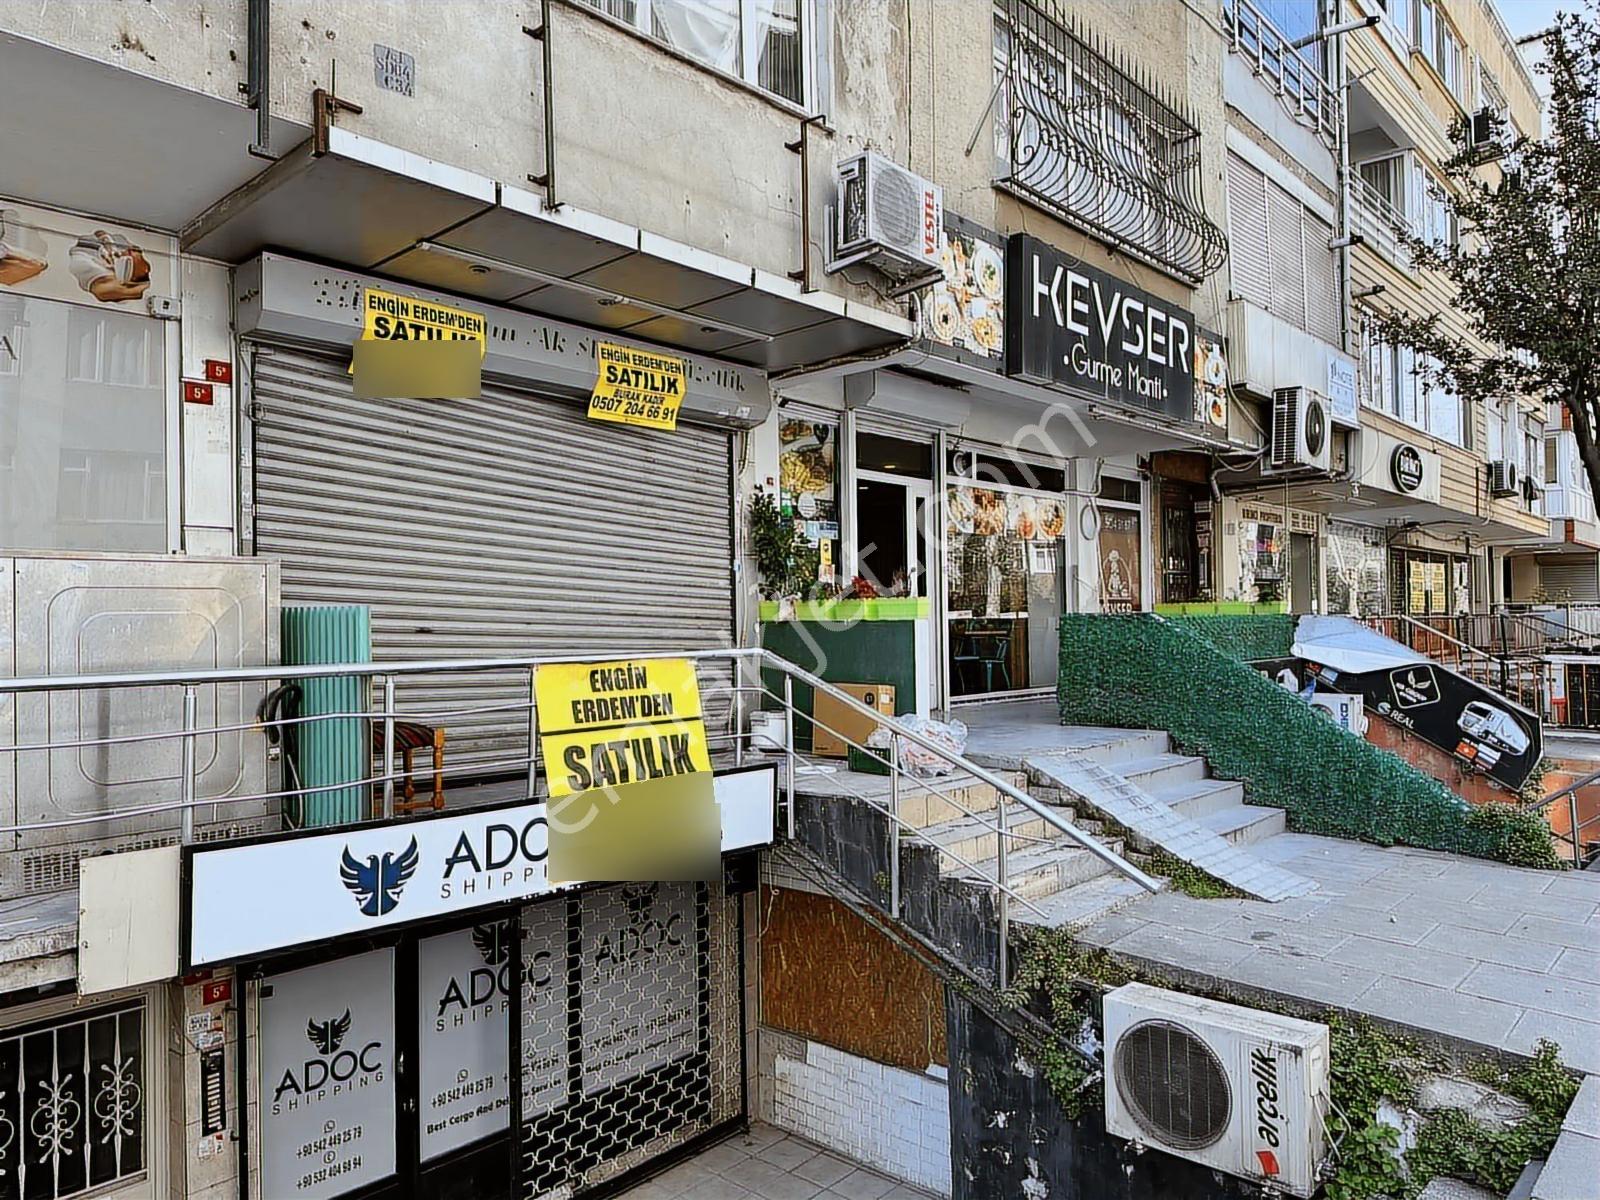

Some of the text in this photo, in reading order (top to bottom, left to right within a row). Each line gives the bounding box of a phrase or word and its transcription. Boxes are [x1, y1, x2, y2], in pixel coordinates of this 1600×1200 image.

[924, 189, 936, 255] VESTEL
[413, 305, 481, 333] ERDEM'DEN
[1032, 254, 1189, 374] KEVSER
[606, 364, 680, 395] SATILIK
[1071, 341, 1123, 388] Gurme
[591, 394, 676, 422] 0507 204 66 91
[589, 662, 648, 693] ENGİN
[571, 692, 674, 724] ERDEM'DEN
[563, 732, 697, 792] SATILIK
[443, 816, 548, 879] ADO
[440, 863, 548, 899] SHIPPI
[435, 986, 554, 1032] SHIPPNG
[272, 1071, 384, 1116] SHIPPING
[273, 1041, 382, 1102] ADOC
[1250, 1047, 1287, 1148] arçelik
[426, 1119, 447, 1135] Best
[449, 1111, 475, 1125] Cargo
